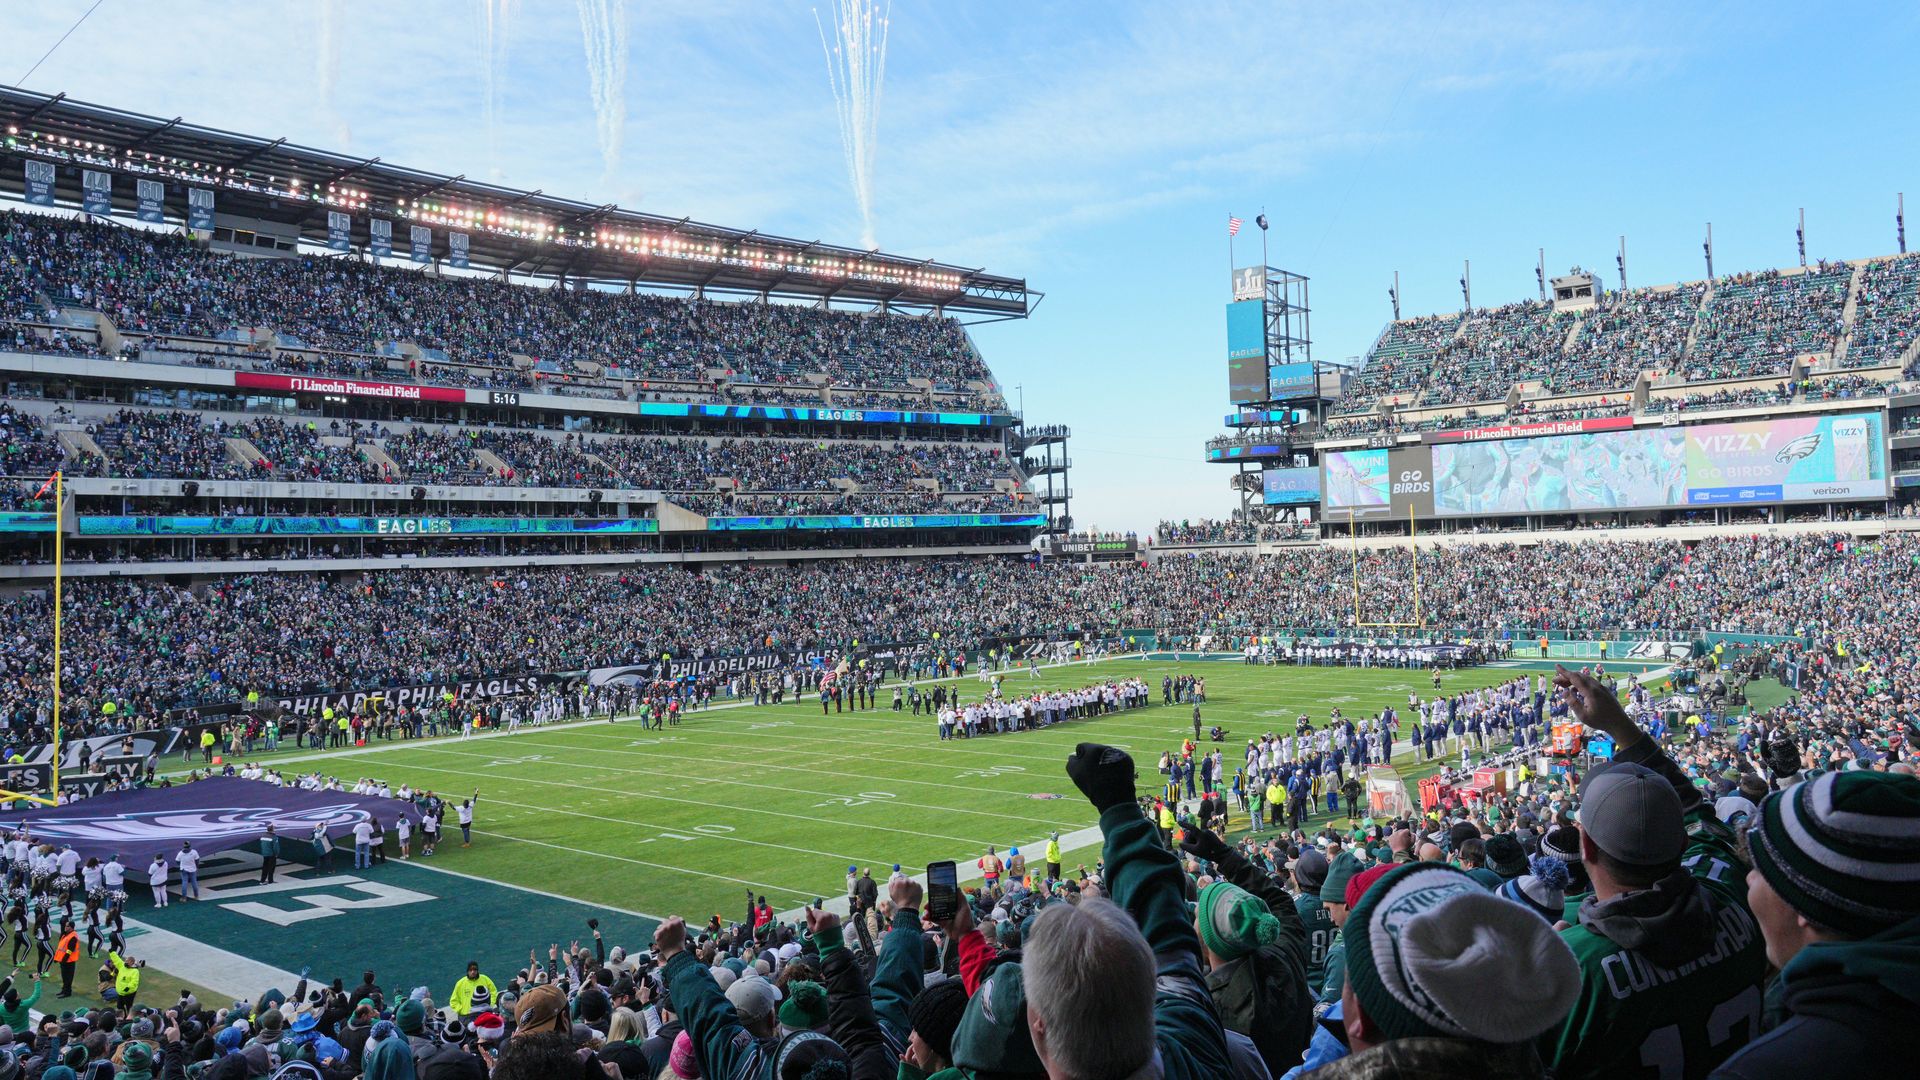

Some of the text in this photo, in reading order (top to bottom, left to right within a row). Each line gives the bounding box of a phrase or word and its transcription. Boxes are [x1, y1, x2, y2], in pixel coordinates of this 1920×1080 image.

[28, 161, 54, 184] 92
[85, 171, 109, 193] 44
[140, 181, 162, 202] 60
[190, 188, 213, 209] 70
[373, 219, 390, 238] 40
[451, 233, 468, 251] 20
[303, 379, 420, 399] Lincoln Financial Field
[493, 392, 516, 405] 5:16
[818, 410, 863, 421] EAGLES
[1474, 421, 1583, 440] Lincoln Financial Field
[1834, 427, 1864, 437] VIZZY
[1371, 437, 1393, 447] 5:16
[1694, 432, 1772, 452] VIZZY
[1401, 470, 1422, 483] GO
[1698, 465, 1773, 479] GO BIRDS
[1393, 481, 1431, 494] BIRDS
[1812, 486, 1850, 496] verizon
[378, 519, 452, 533] EAGLES
[864, 517, 914, 528] EAGLES
[1061, 543, 1096, 552] UNIBET
[670, 653, 781, 678] PHILADELPHIA
[461, 676, 538, 699] EAGLES
[825, 791, 897, 808] 20
[657, 824, 736, 842] 10
[1600, 900, 1758, 1000] CUNGHAM
